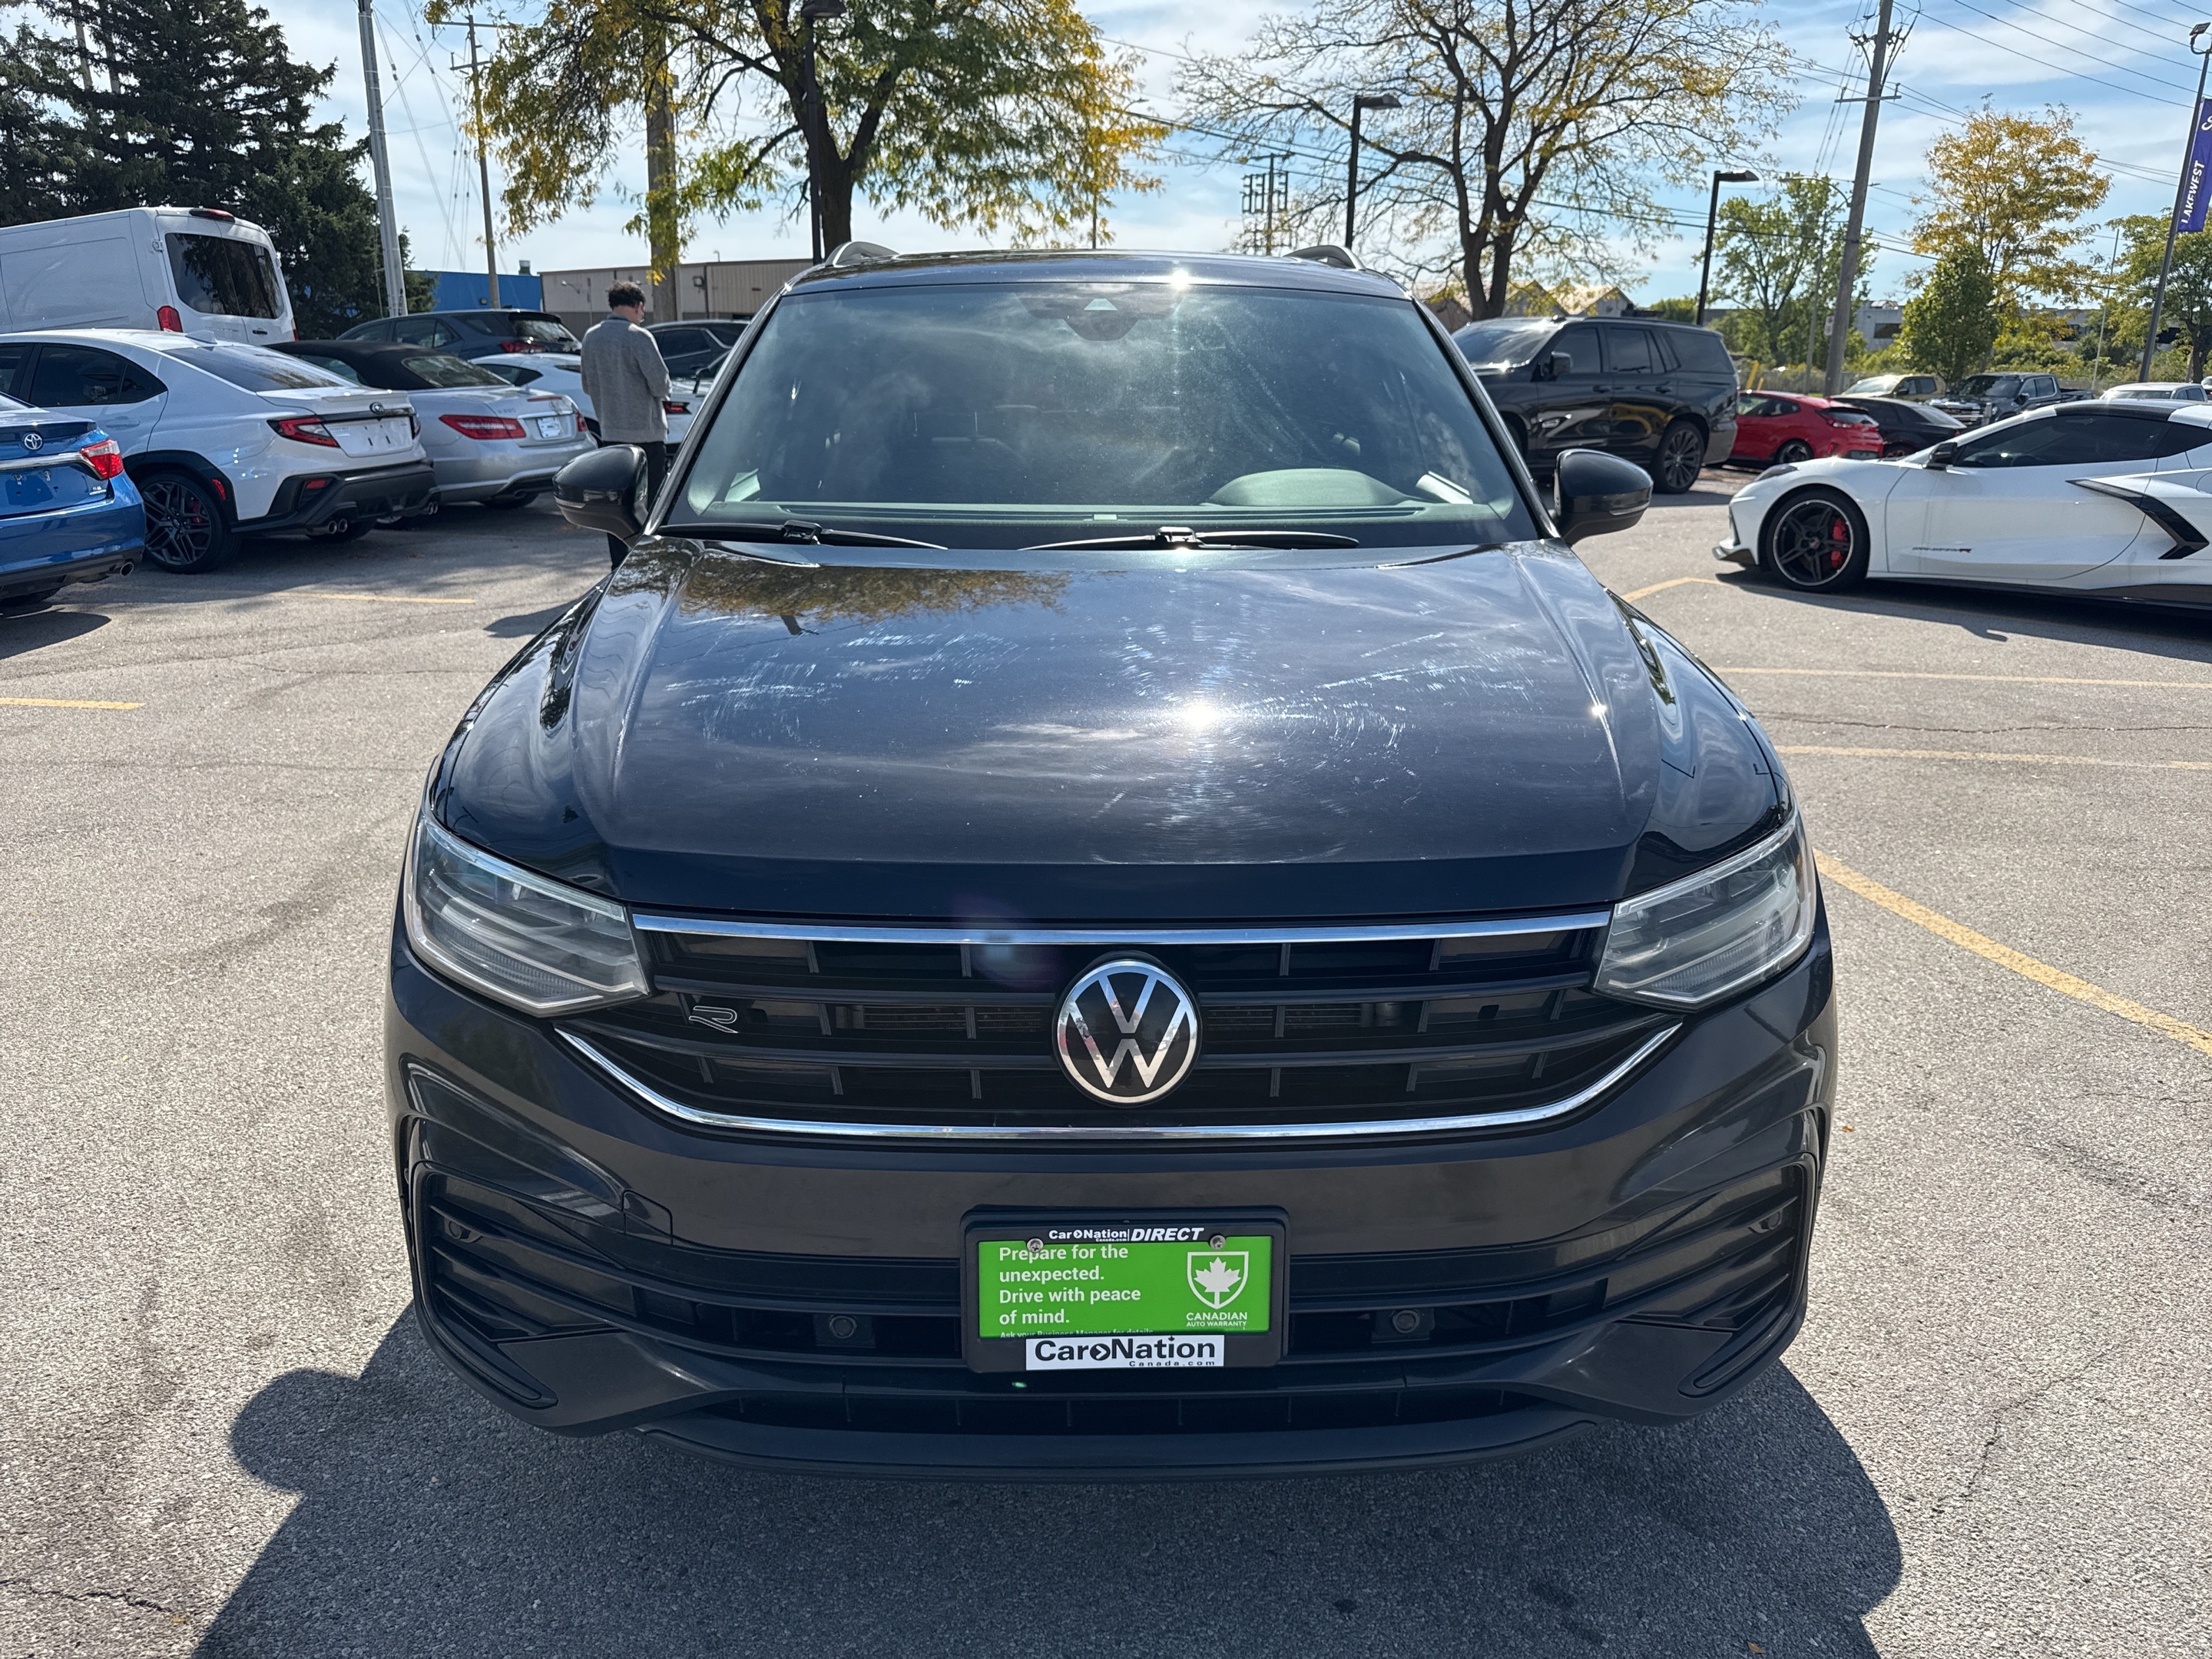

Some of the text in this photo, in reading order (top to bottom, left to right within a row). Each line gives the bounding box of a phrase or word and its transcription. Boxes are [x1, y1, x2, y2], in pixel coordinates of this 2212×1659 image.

[1131, 1227, 1204, 1241] DIRECT
[999, 1243, 1128, 1263] Prepare for the
[999, 1265, 1104, 1285] unexpected.
[999, 1286, 1141, 1305] Drive with peace
[999, 1308, 1070, 1325] of mind.
[1186, 1312, 1247, 1320] CANADIAN
